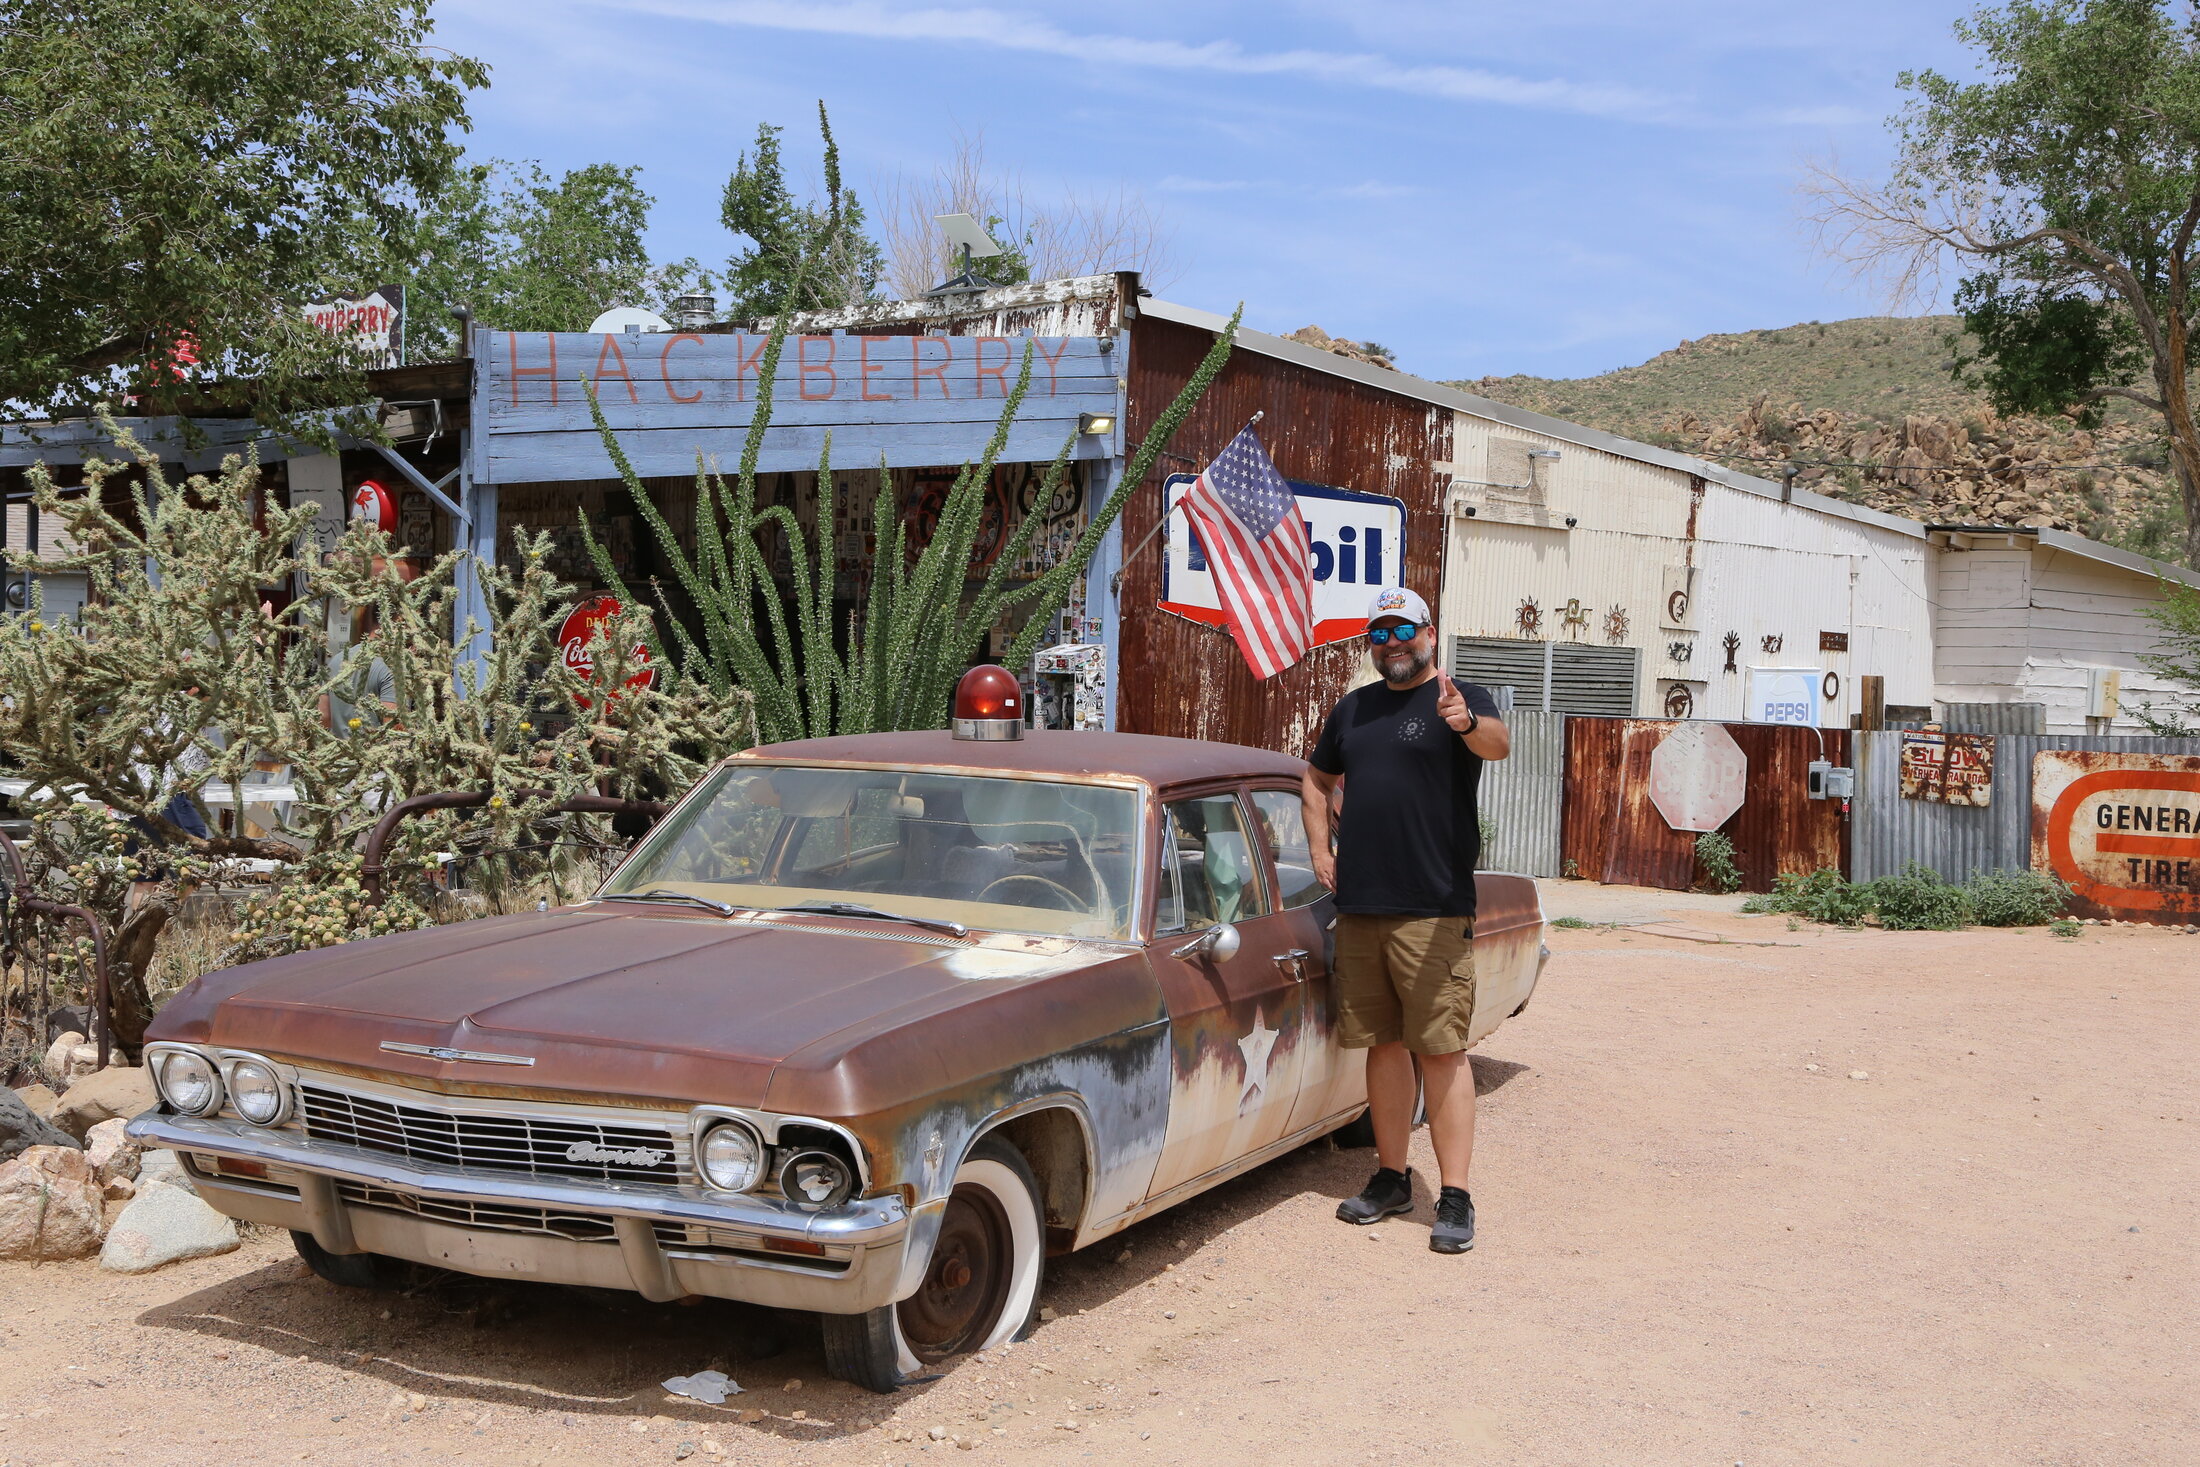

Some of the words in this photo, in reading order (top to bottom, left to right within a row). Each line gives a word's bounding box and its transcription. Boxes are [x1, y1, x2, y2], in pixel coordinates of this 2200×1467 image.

[508, 331, 1069, 408] HACKBERRY
[1188, 521, 1382, 585] bil
[1764, 702, 1809, 722] PEPSI
[1911, 746, 1983, 767] SLOW
[1656, 758, 1741, 798] SOP
[1902, 766, 1942, 781] OVERHEA
[2127, 858, 2190, 886] TIRE
[565, 1141, 667, 1167] Chevrolet
